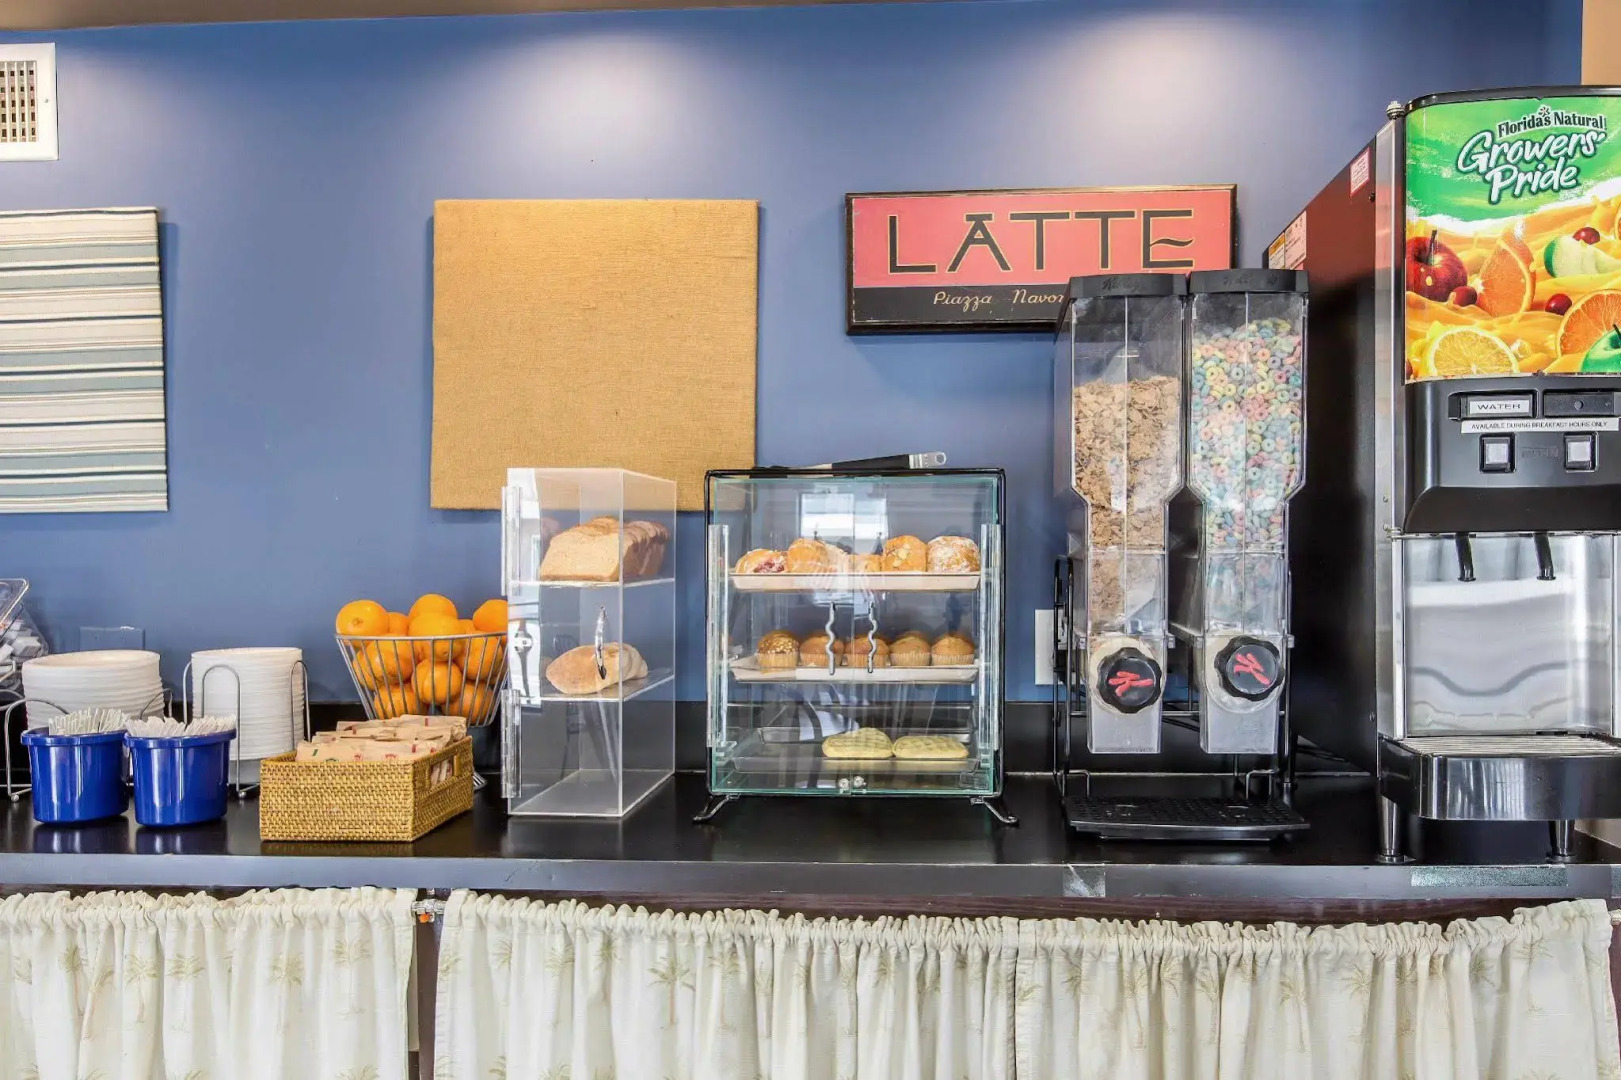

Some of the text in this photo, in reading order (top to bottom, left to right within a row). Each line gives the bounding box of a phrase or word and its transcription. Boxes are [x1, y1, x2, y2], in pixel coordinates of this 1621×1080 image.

[1484, 157, 1578, 204] Pride
[887, 207, 1195, 275] LATTE
[933, 290, 993, 312] Piazza
[1471, 422, 1505, 430] AVAILABLE
[1531, 421, 1568, 429] BREAKFAST
